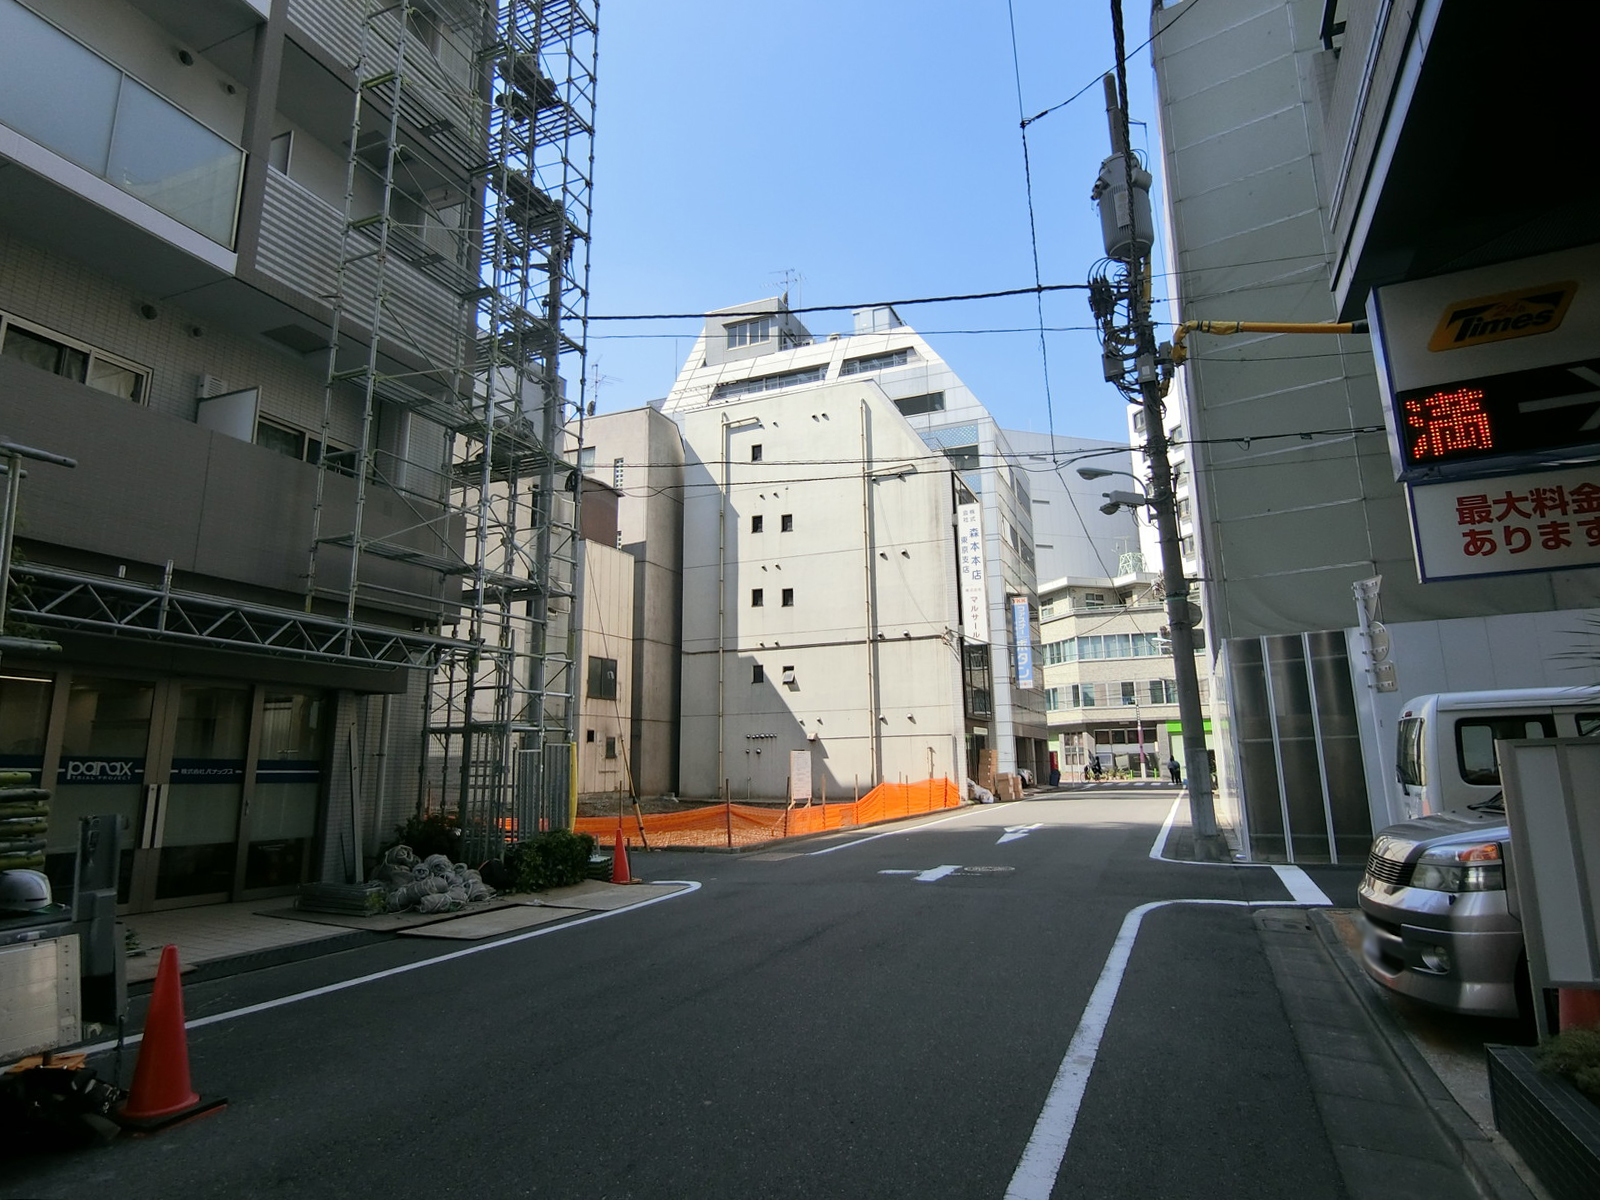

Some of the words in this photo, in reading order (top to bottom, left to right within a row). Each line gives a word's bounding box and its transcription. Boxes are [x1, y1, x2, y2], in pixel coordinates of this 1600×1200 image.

[1453, 308, 1555, 342] Times
[1405, 388, 1493, 459] 満
[1456, 482, 1600, 525] 最大料金
[969, 527, 982, 580] 森本本店
[1462, 516, 1600, 557] あります
[66, 761, 133, 780] panax
